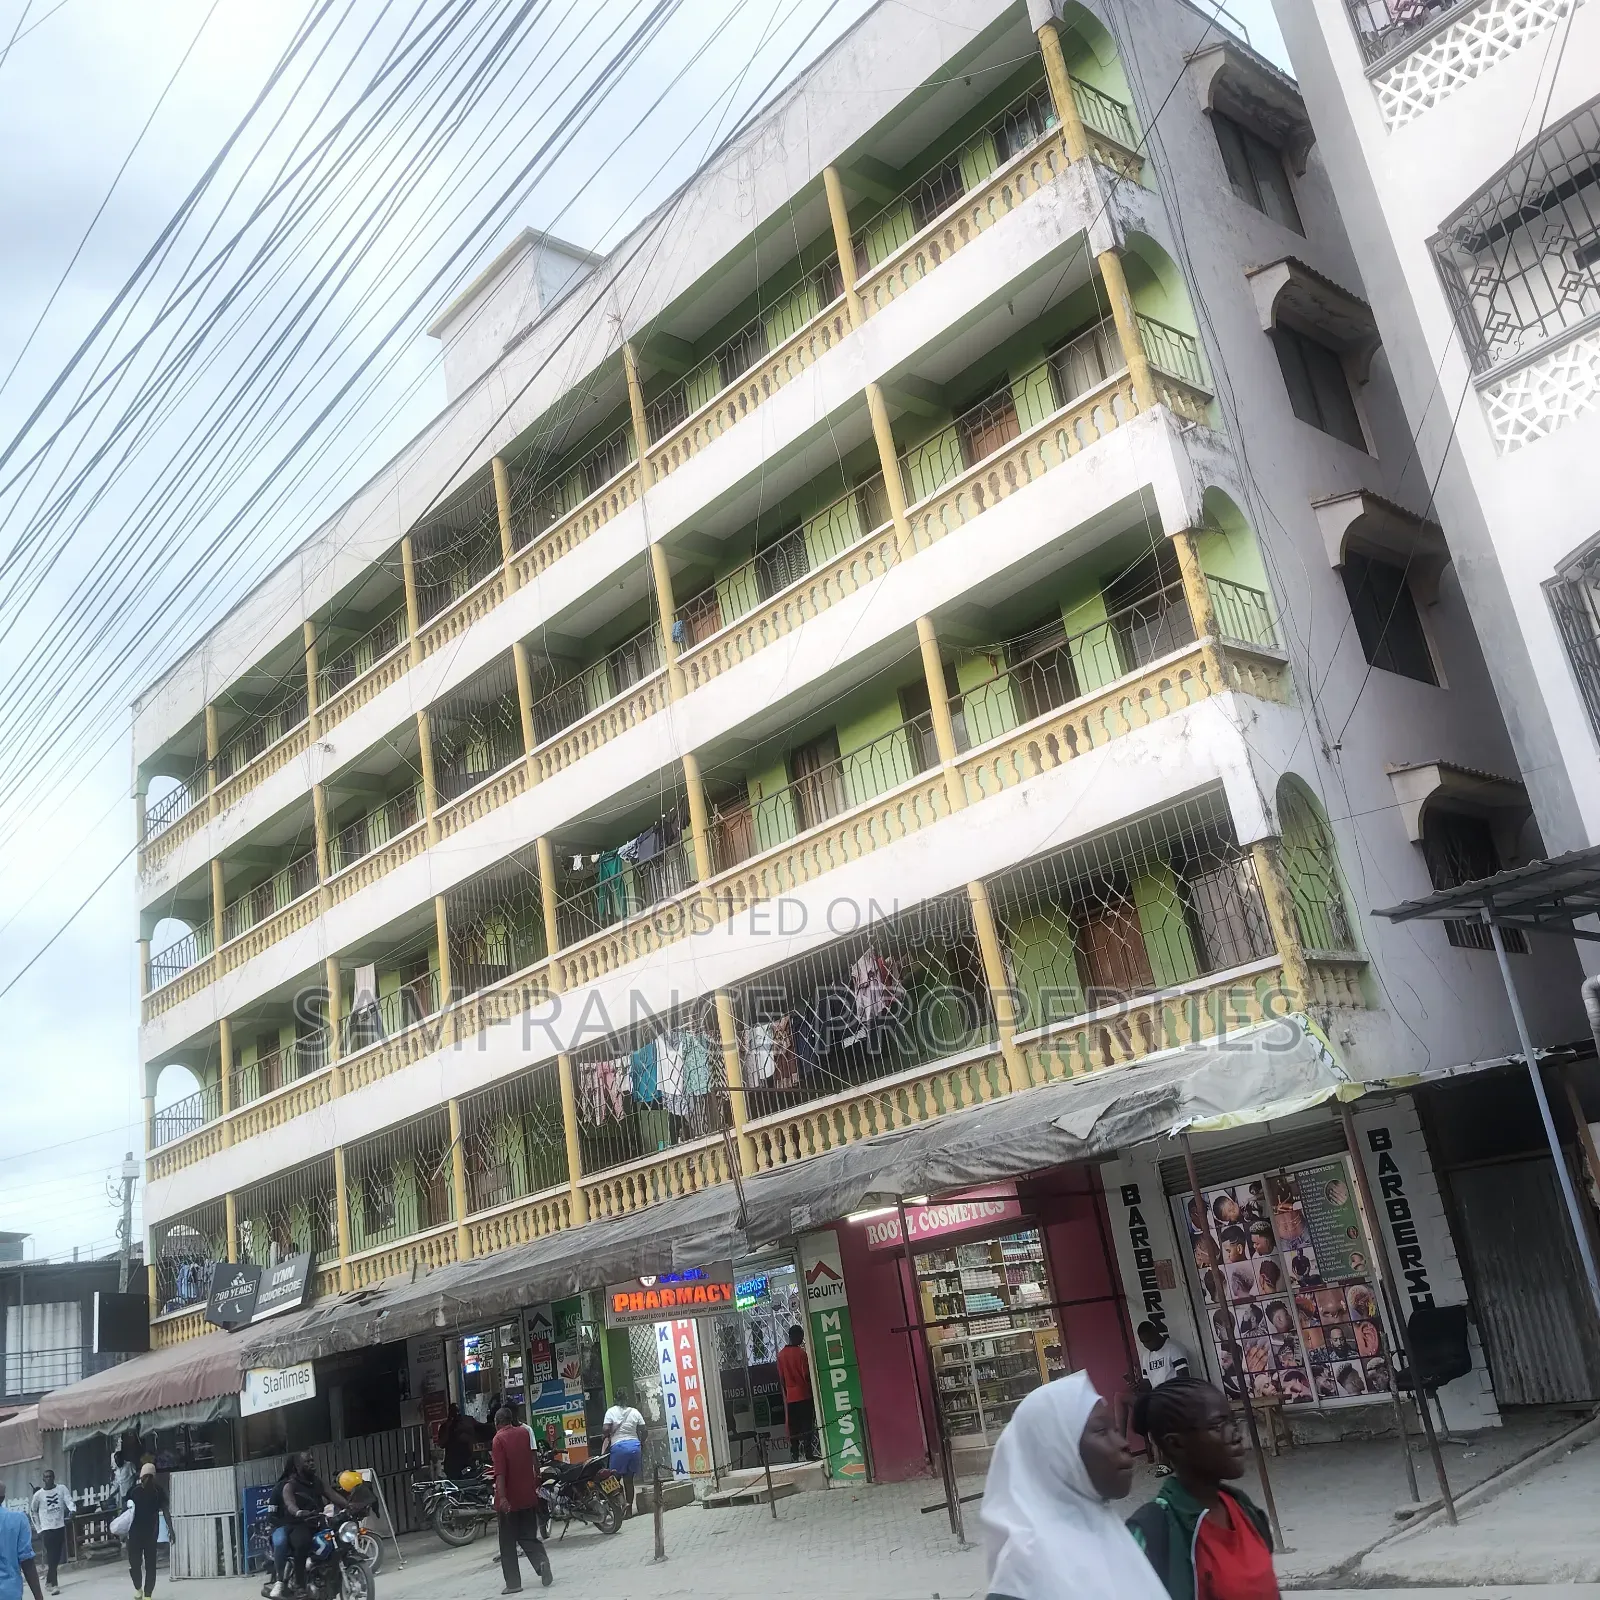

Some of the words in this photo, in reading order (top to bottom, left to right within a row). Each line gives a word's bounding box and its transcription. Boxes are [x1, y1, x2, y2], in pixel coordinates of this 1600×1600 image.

[918, 1200, 1005, 1232] COSMETICS
[1367, 1128, 1436, 1312] BARBERSH
[215, 1290, 229, 1302] 200
[230, 1283, 253, 1298] YEARS
[737, 1276, 766, 1295] CHEMIST
[808, 1282, 844, 1299] EQUITY
[612, 1283, 732, 1313] PHARMACY
[263, 1368, 310, 1394] StarTimes
[534, 1373, 553, 1384] BANK
[677, 1318, 703, 1452] HARMACY
[752, 1382, 779, 1395] EQUITY
[568, 1436, 587, 1446] SERVIC
